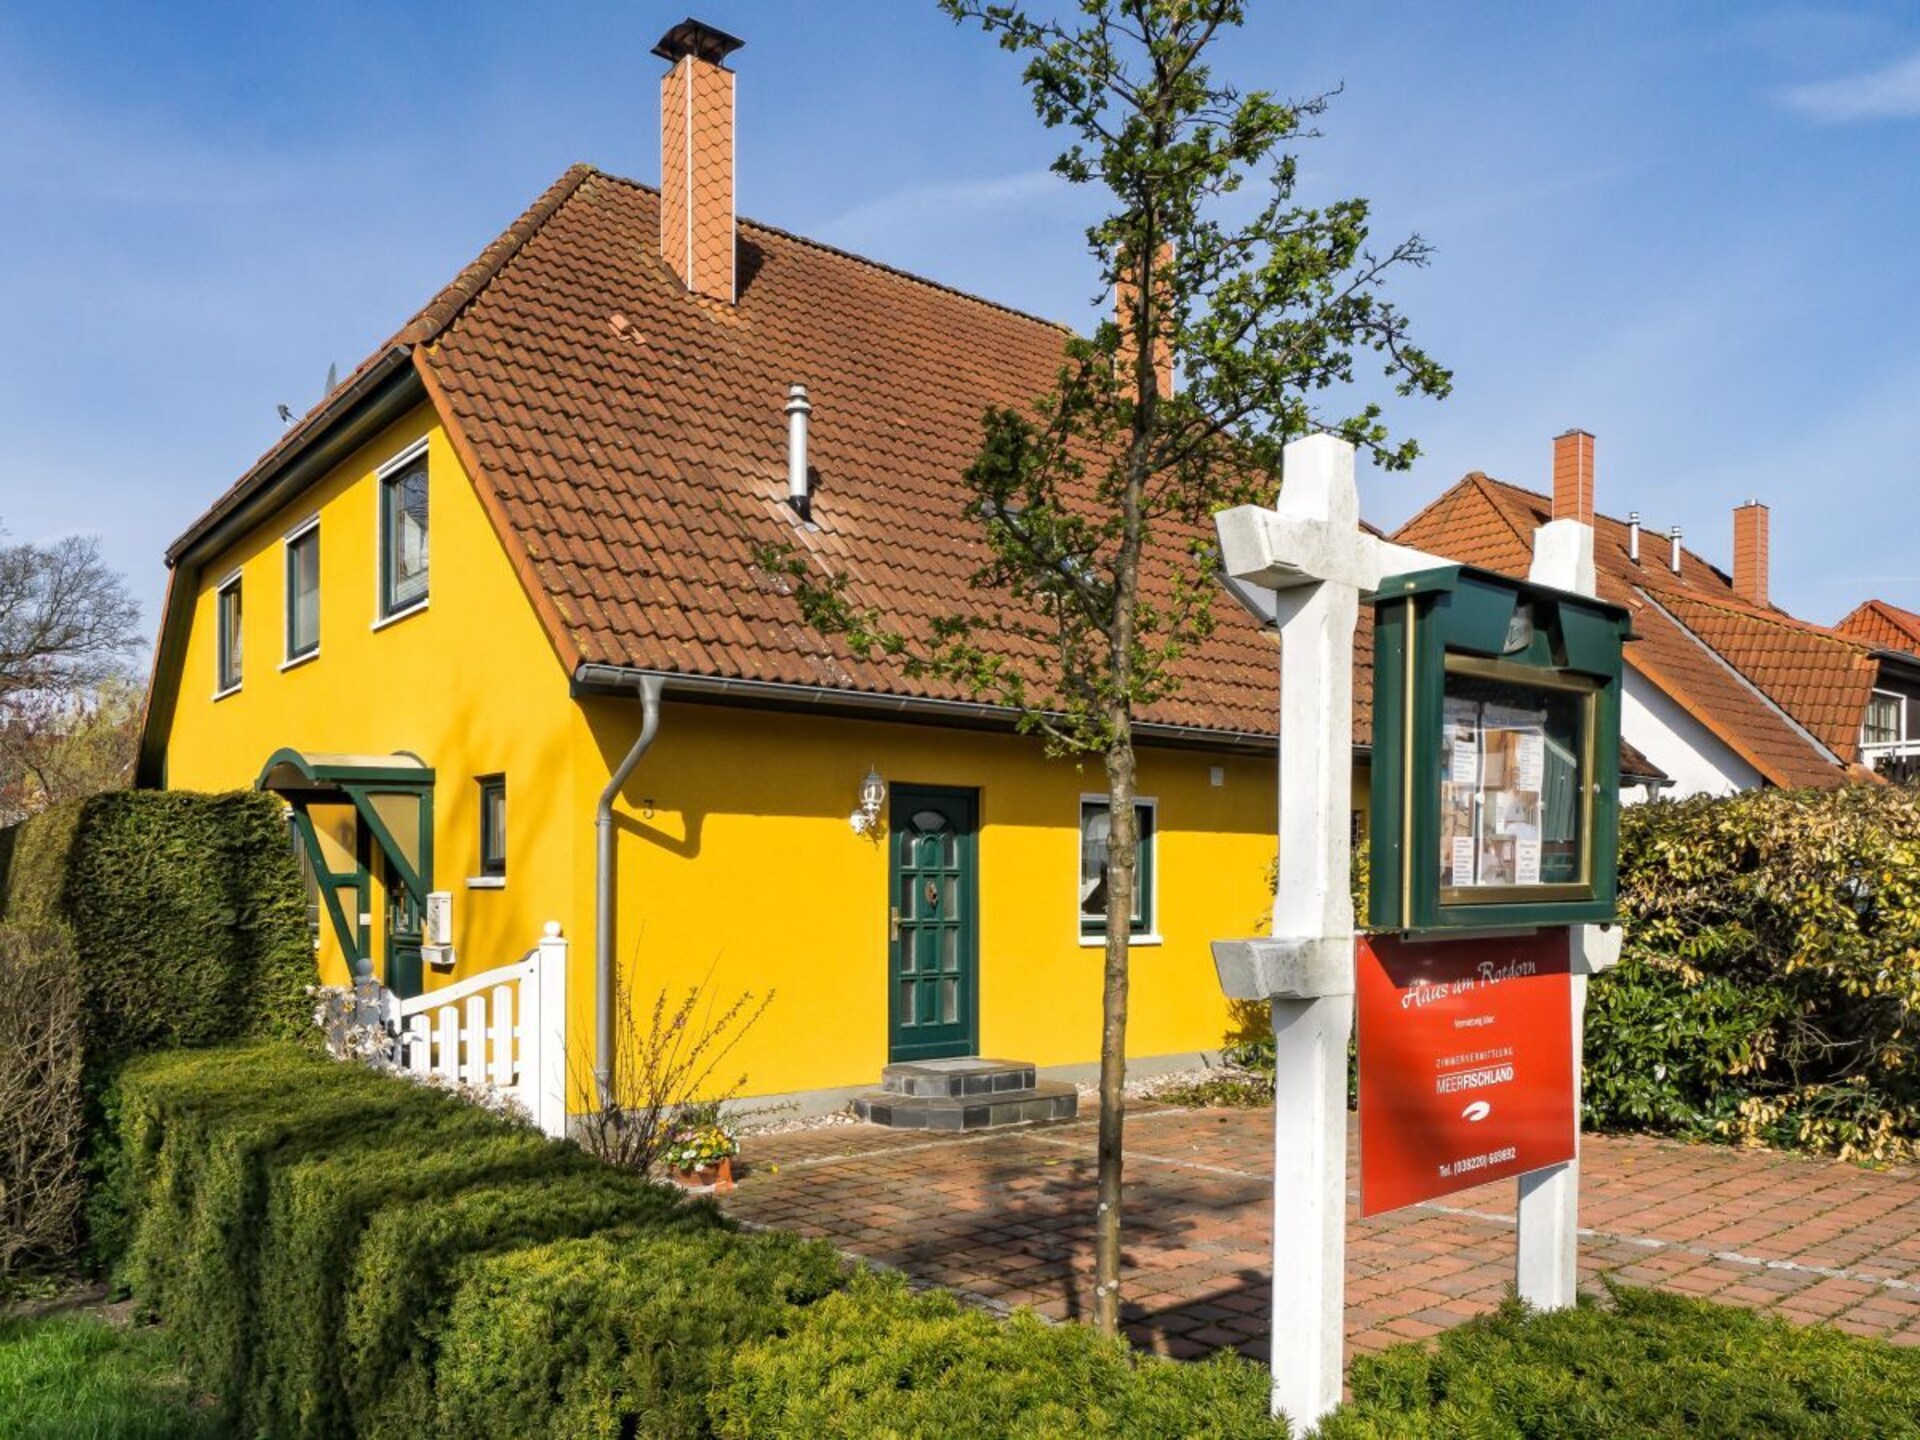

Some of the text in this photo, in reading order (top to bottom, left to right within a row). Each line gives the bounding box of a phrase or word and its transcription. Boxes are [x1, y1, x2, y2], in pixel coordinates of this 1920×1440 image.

[1401, 959, 1536, 1009] Haus am Rotdorn
[1436, 1066, 1514, 1094] MEERFISCHLAND
